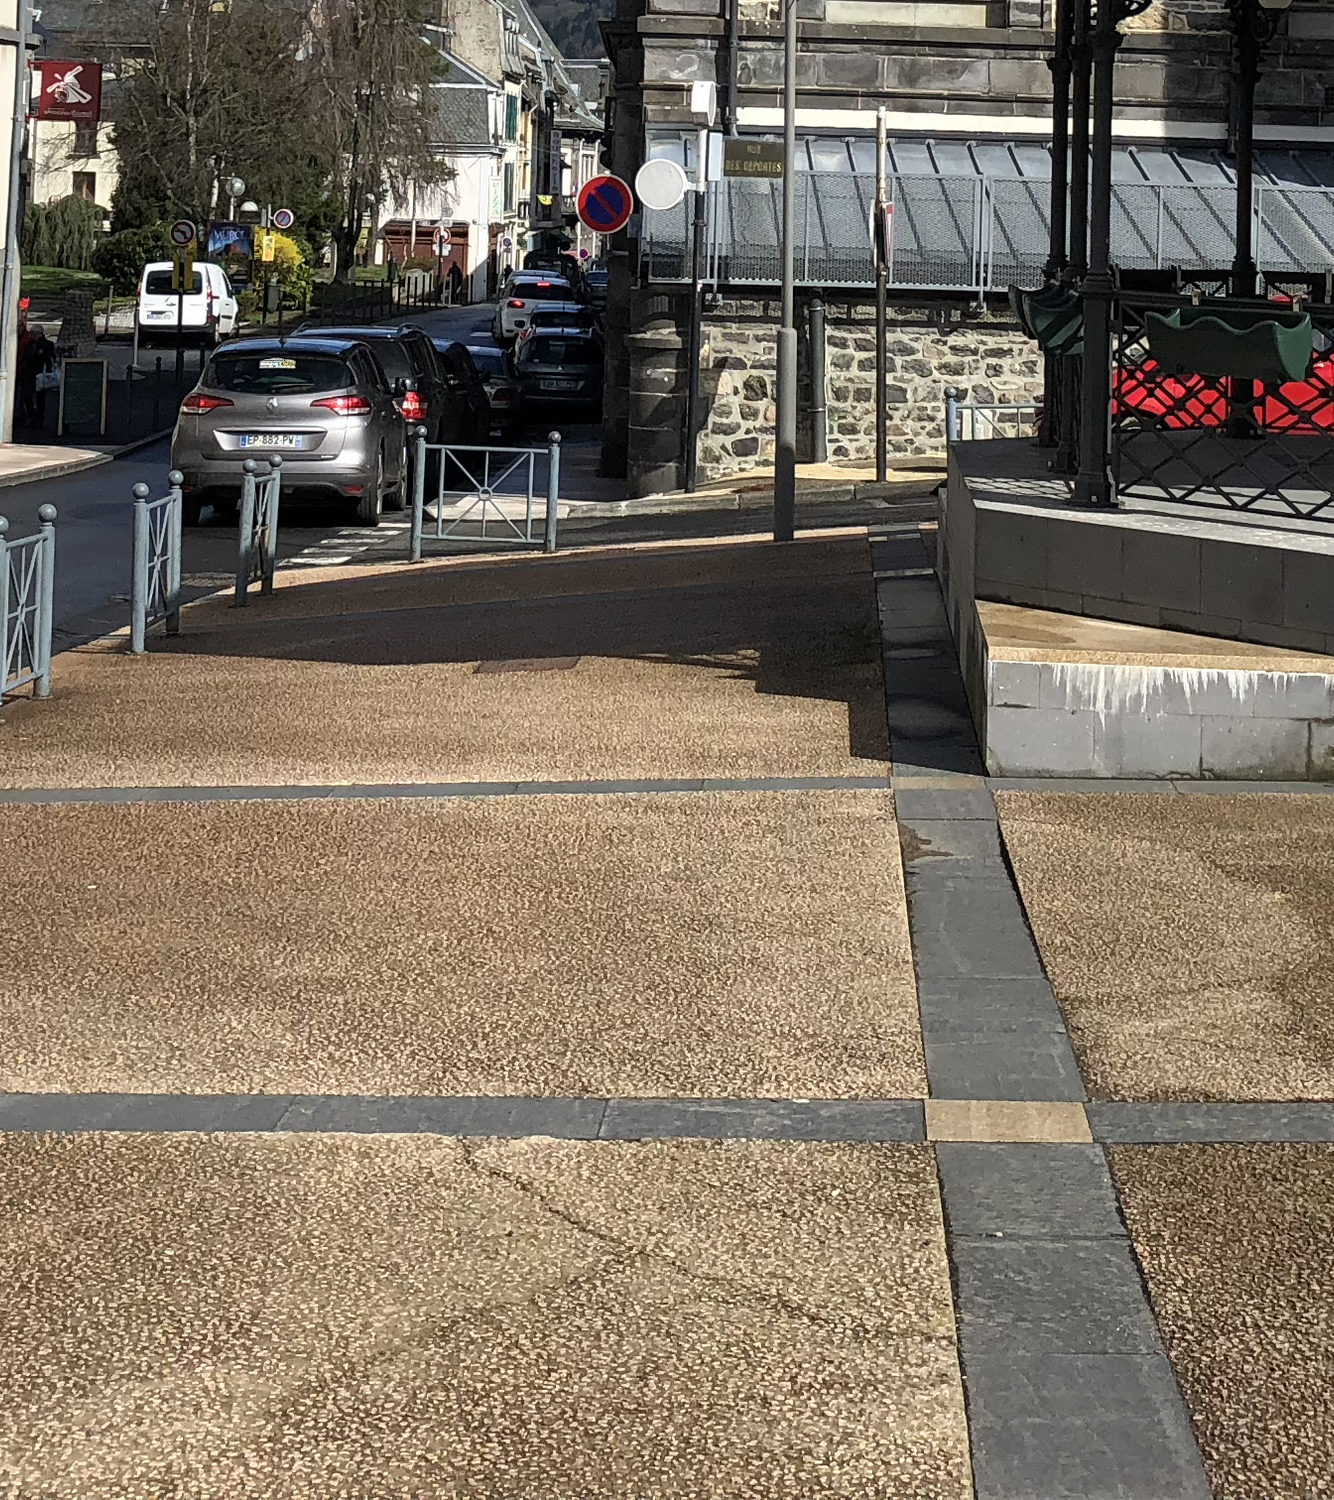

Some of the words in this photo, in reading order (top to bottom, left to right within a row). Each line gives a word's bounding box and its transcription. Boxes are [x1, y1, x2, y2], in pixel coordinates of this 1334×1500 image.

[746, 144, 762, 155] RUE
[725, 160, 741, 171] DES
[492, 182, 500, 216] PIZZA
